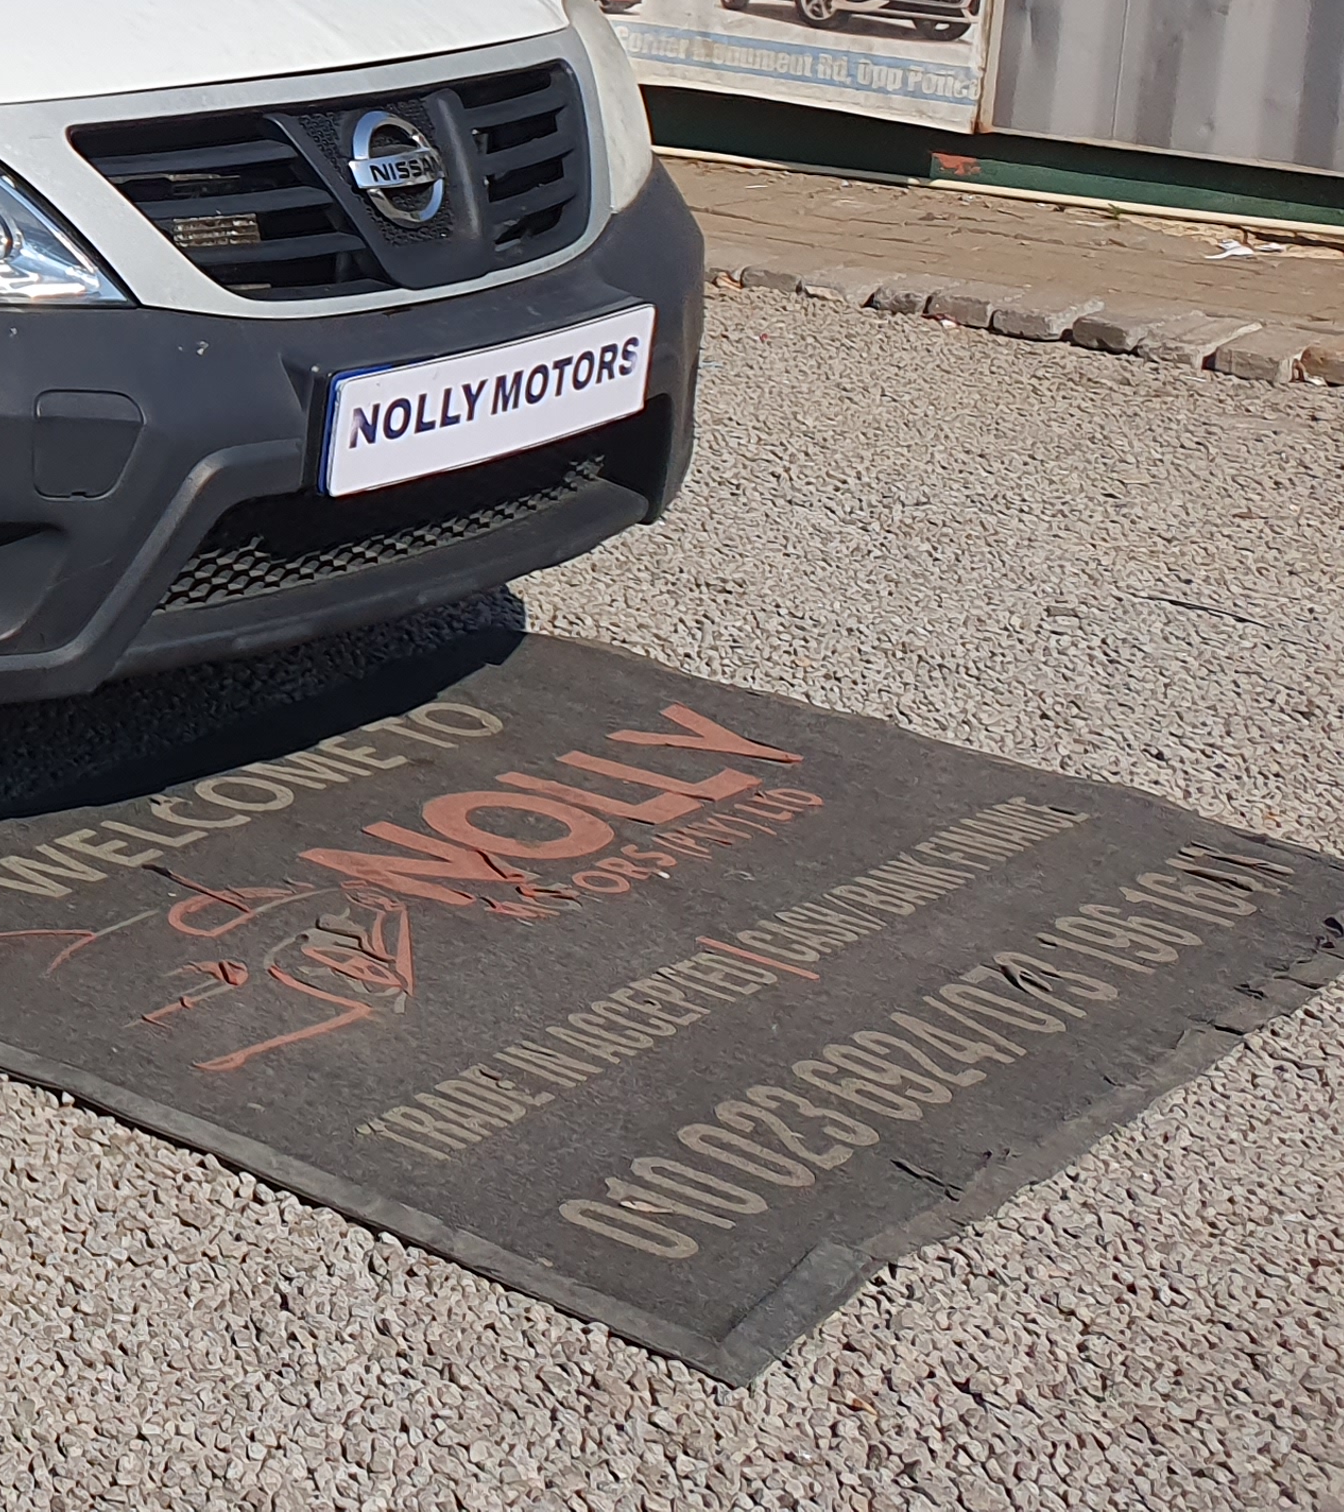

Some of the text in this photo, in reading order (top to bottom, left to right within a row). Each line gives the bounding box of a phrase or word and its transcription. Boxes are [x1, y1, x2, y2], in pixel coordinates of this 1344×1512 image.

[368, 153, 443, 183] NISSAN
[348, 336, 641, 450] NOLLY MOTORS
[360, 701, 505, 750] TO
[297, 700, 805, 907] NOLLY
[914, 796, 1091, 872] FINANCE
[484, 842, 678, 921] MORS
[544, 949, 779, 1065] ACCEPTED
[493, 1039, 605, 1089] IN
[558, 1155, 770, 1260] 010
[676, 1084, 881, 1189] 023
[1035, 903, 1205, 975] 196
[355, 1062, 556, 1162] TRADE
